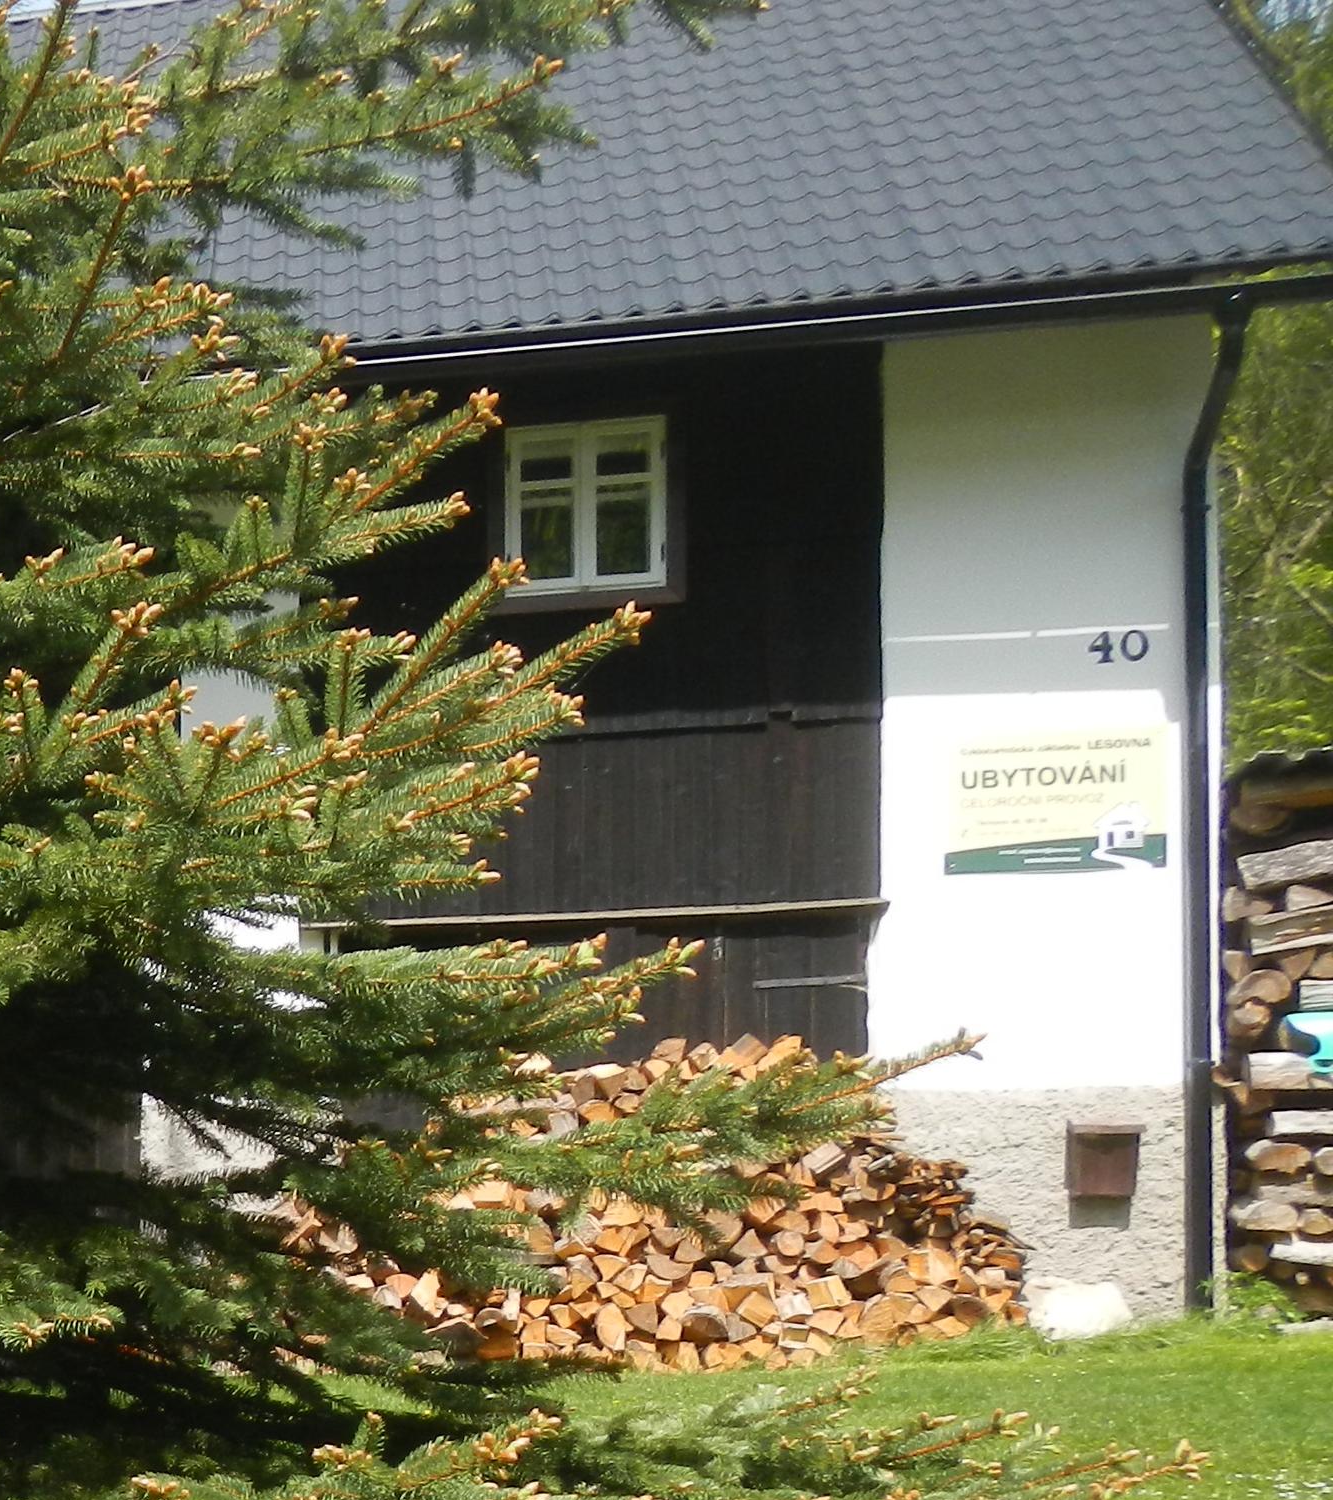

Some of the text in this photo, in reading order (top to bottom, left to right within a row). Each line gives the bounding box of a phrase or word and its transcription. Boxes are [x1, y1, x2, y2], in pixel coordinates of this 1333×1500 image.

[1087, 629, 1149, 664] 40
[1087, 738, 1152, 750] LESOVNA
[961, 759, 1126, 790] UBYTOVÁNÍ
